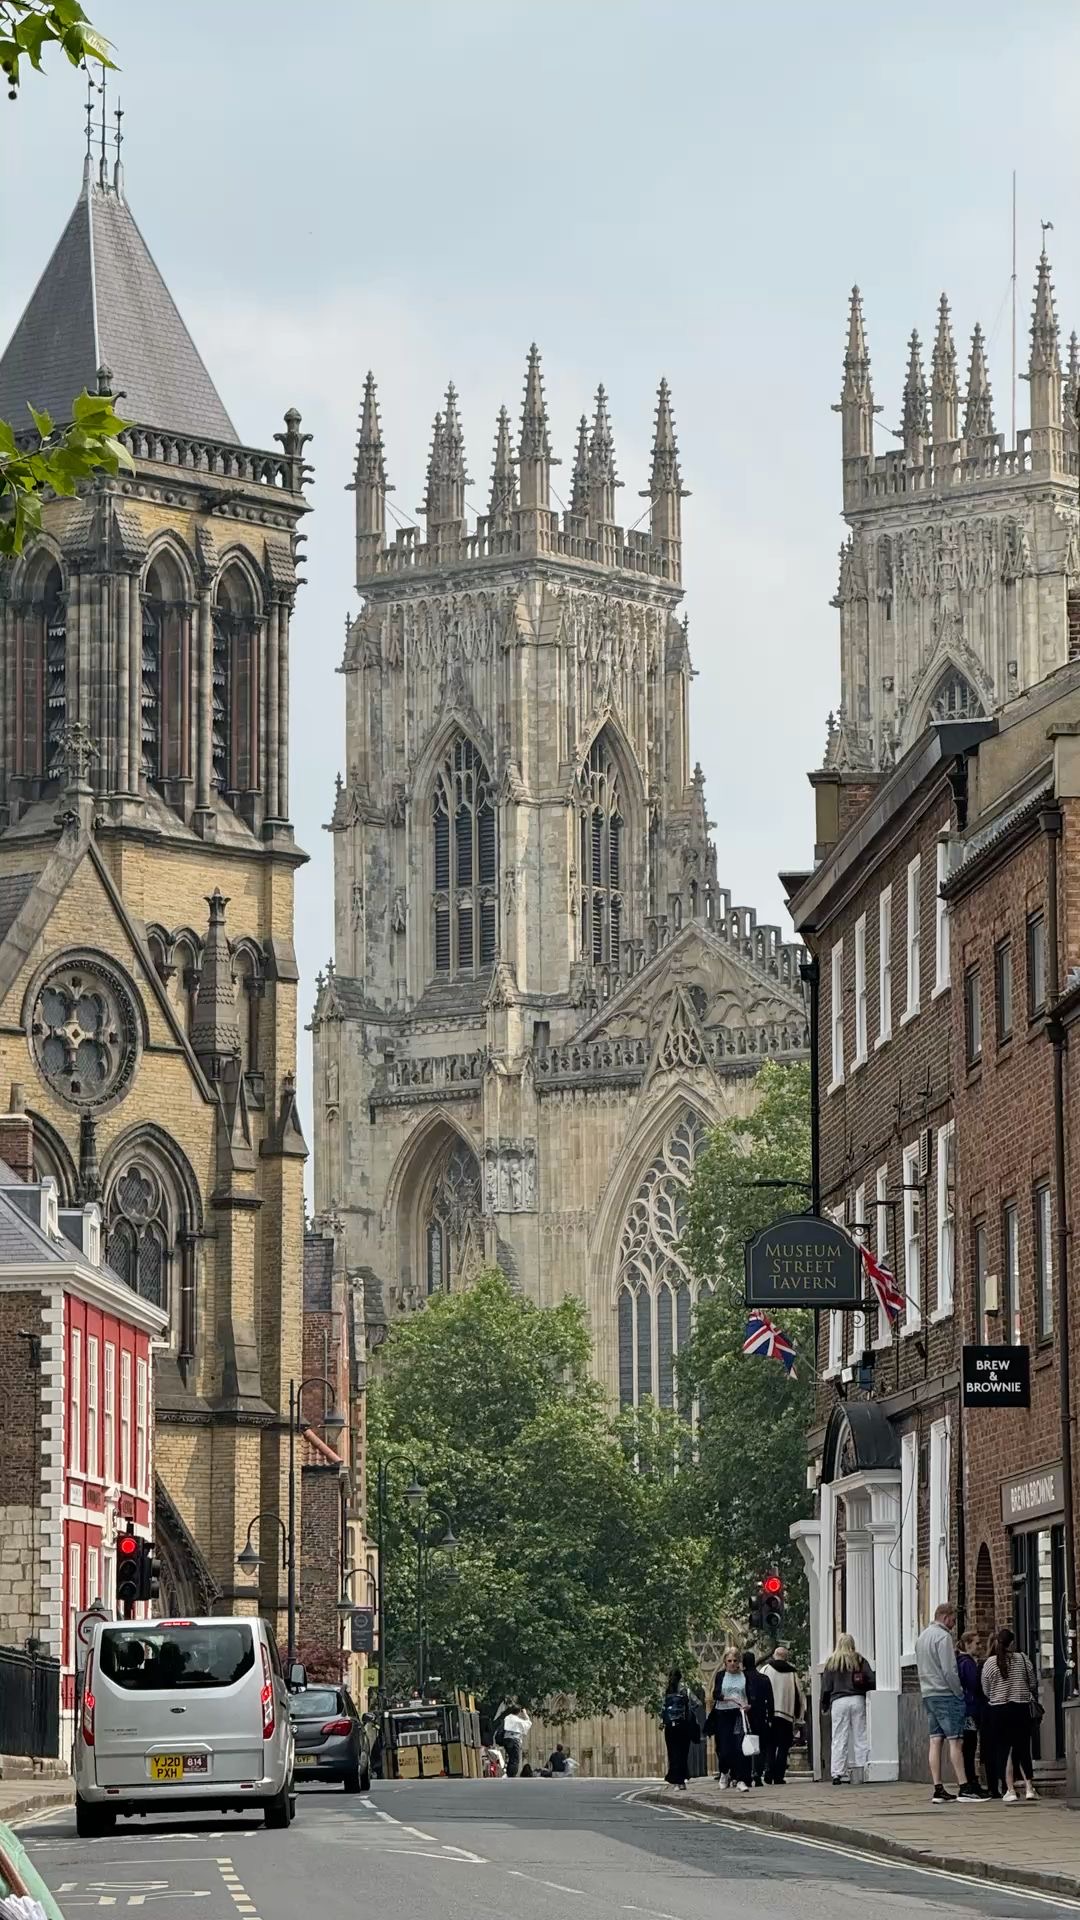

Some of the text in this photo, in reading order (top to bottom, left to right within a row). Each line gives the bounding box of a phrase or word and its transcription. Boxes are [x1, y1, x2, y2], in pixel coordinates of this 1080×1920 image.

[765, 1243, 841, 1257] MUSEUM
[773, 1259, 835, 1274] STREET
[769, 1274, 837, 1289] TAVERN
[976, 1360, 1010, 1370] BREW
[989, 1371, 998, 1381] &
[966, 1382, 1022, 1392] BROWNIE
[154, 1757, 181, 1767] YJ20
[187, 1758, 202, 1766] 814
[157, 1768, 177, 1778] PXH
